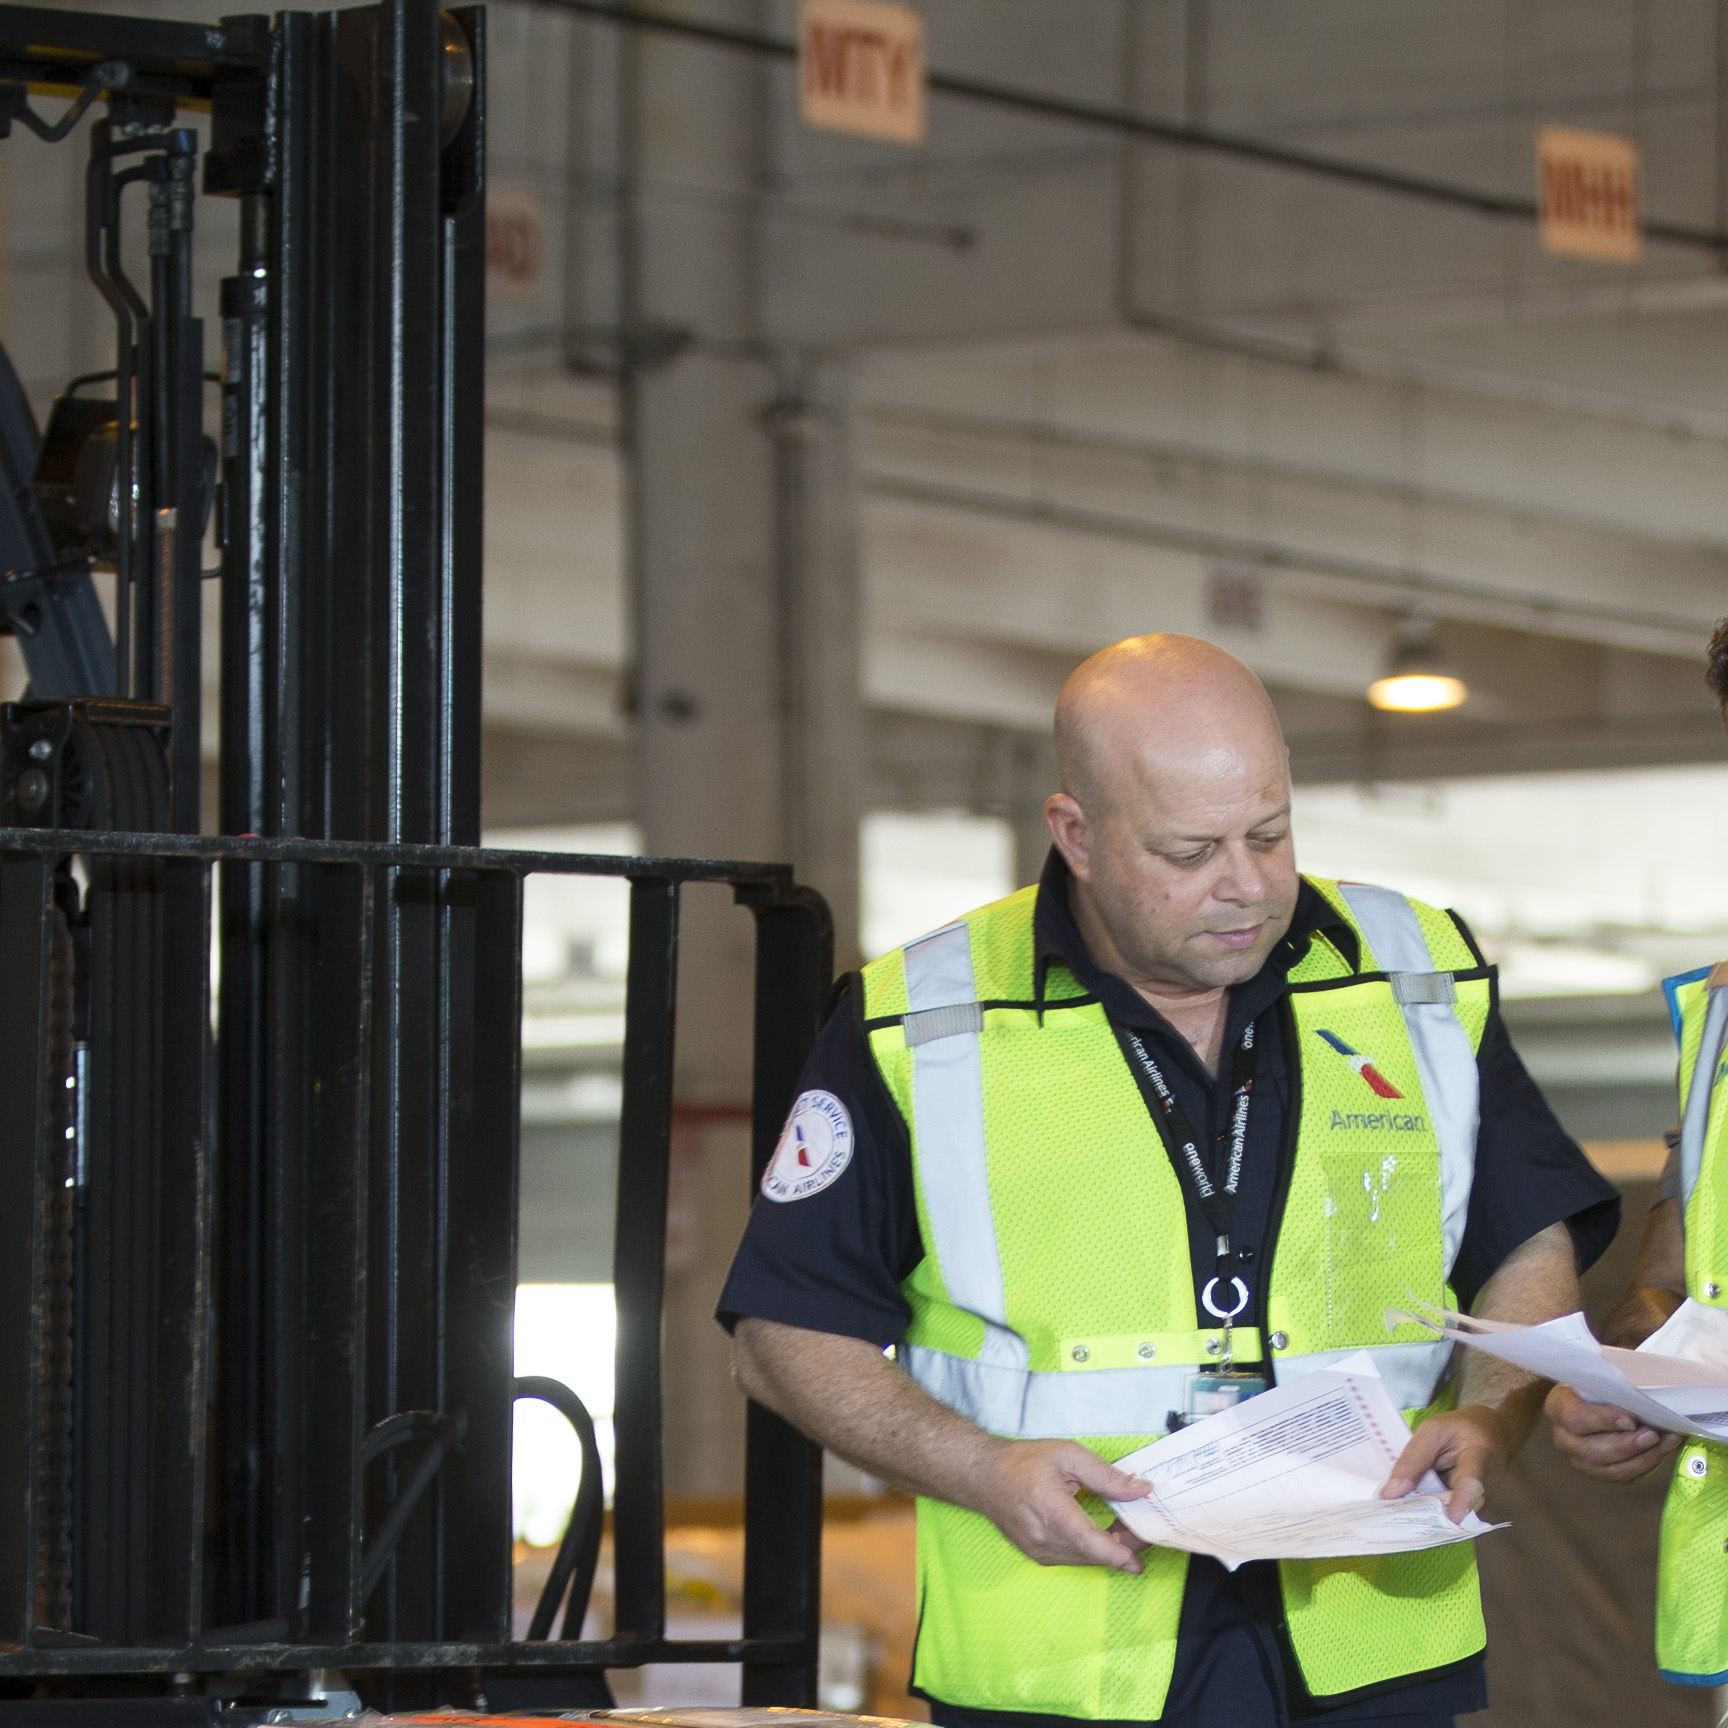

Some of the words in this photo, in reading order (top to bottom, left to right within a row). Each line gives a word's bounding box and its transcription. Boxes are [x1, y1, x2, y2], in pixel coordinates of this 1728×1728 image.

[812, 1096, 849, 1139] SERVICE
[1330, 1109, 1426, 1132] American
[793, 1151, 846, 1195] AIRLINES
[1183, 1142, 1216, 1199] oneworld
[1224, 1137, 1245, 1196] American
